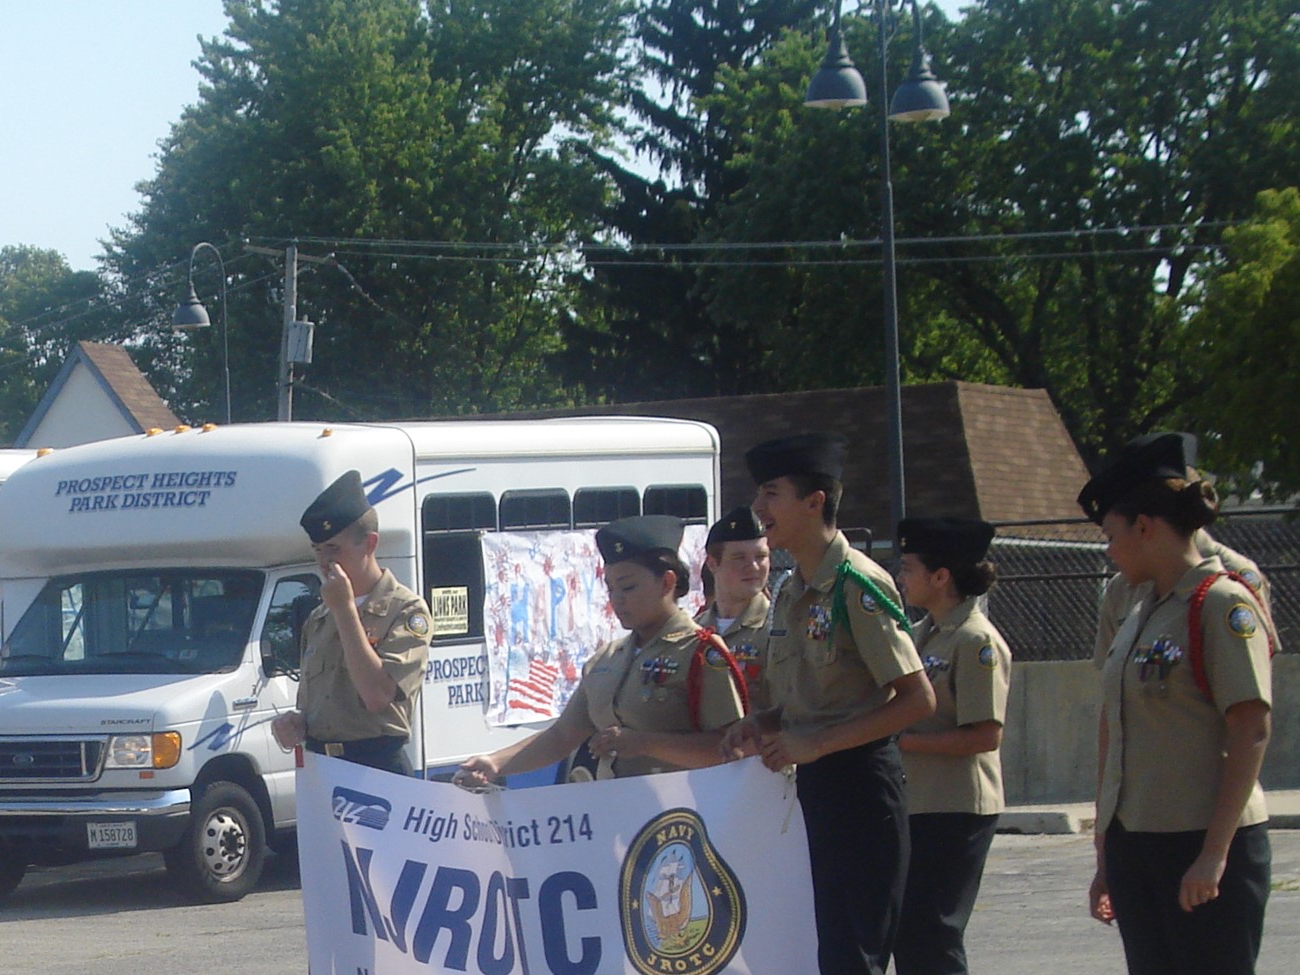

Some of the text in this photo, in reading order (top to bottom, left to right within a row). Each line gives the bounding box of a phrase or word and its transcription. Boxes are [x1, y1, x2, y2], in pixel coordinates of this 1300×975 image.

[55, 471, 237, 496] PROSPECT HEIGHTS
[69, 490, 211, 513] PARK DISTRICT
[425, 655, 489, 681] PROSPEC
[448, 682, 485, 706] PARK
[403, 806, 458, 843] High
[547, 813, 593, 844] 214
[656, 825, 694, 846] NAVY
[647, 943, 715, 972] JROTC
